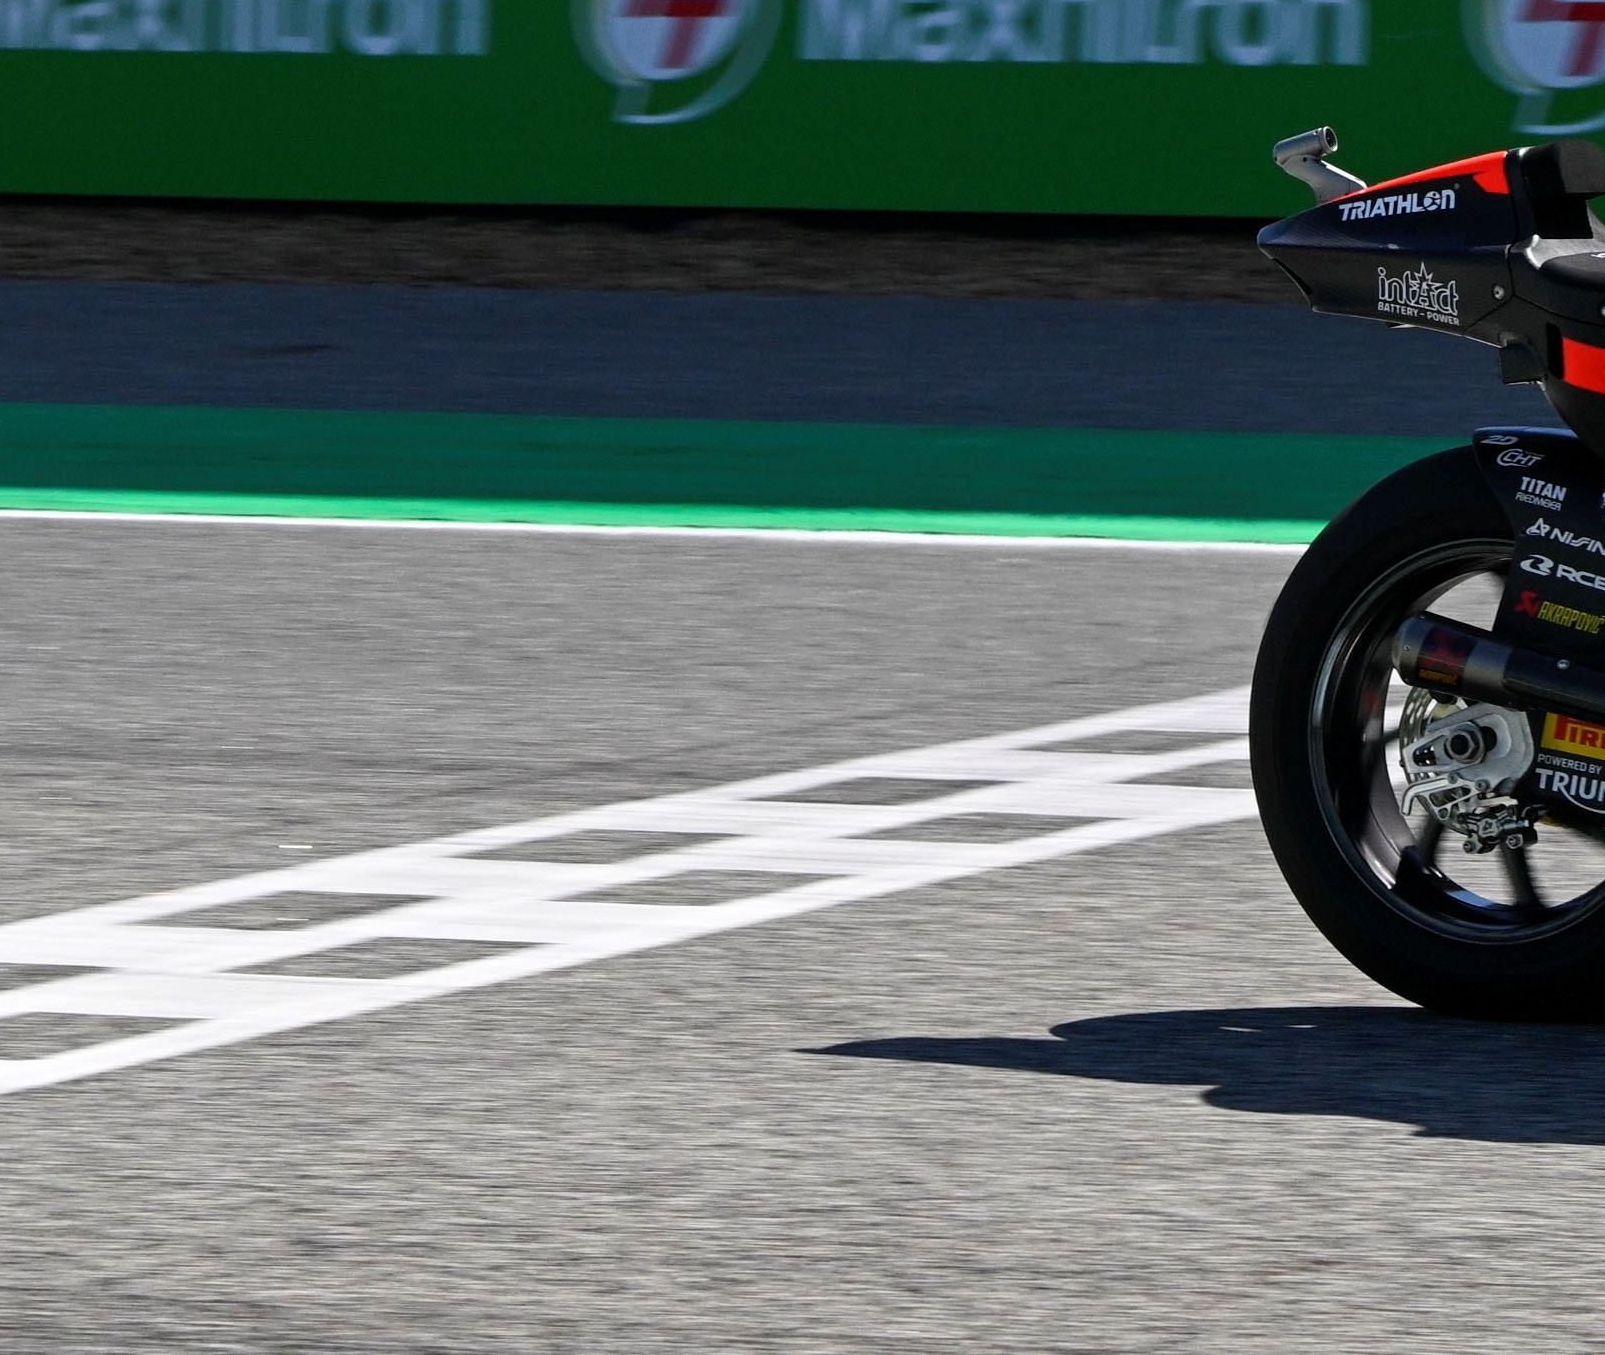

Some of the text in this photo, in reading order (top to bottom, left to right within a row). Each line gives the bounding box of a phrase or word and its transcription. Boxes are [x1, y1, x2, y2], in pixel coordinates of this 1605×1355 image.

[1338, 188, 1456, 222] TRIATHLON
[1376, 301, 1419, 317] BATTERY
[1426, 310, 1461, 327] POWER
[1520, 476, 1567, 502] TITAN
[1536, 752, 1603, 776] POWERED BY
